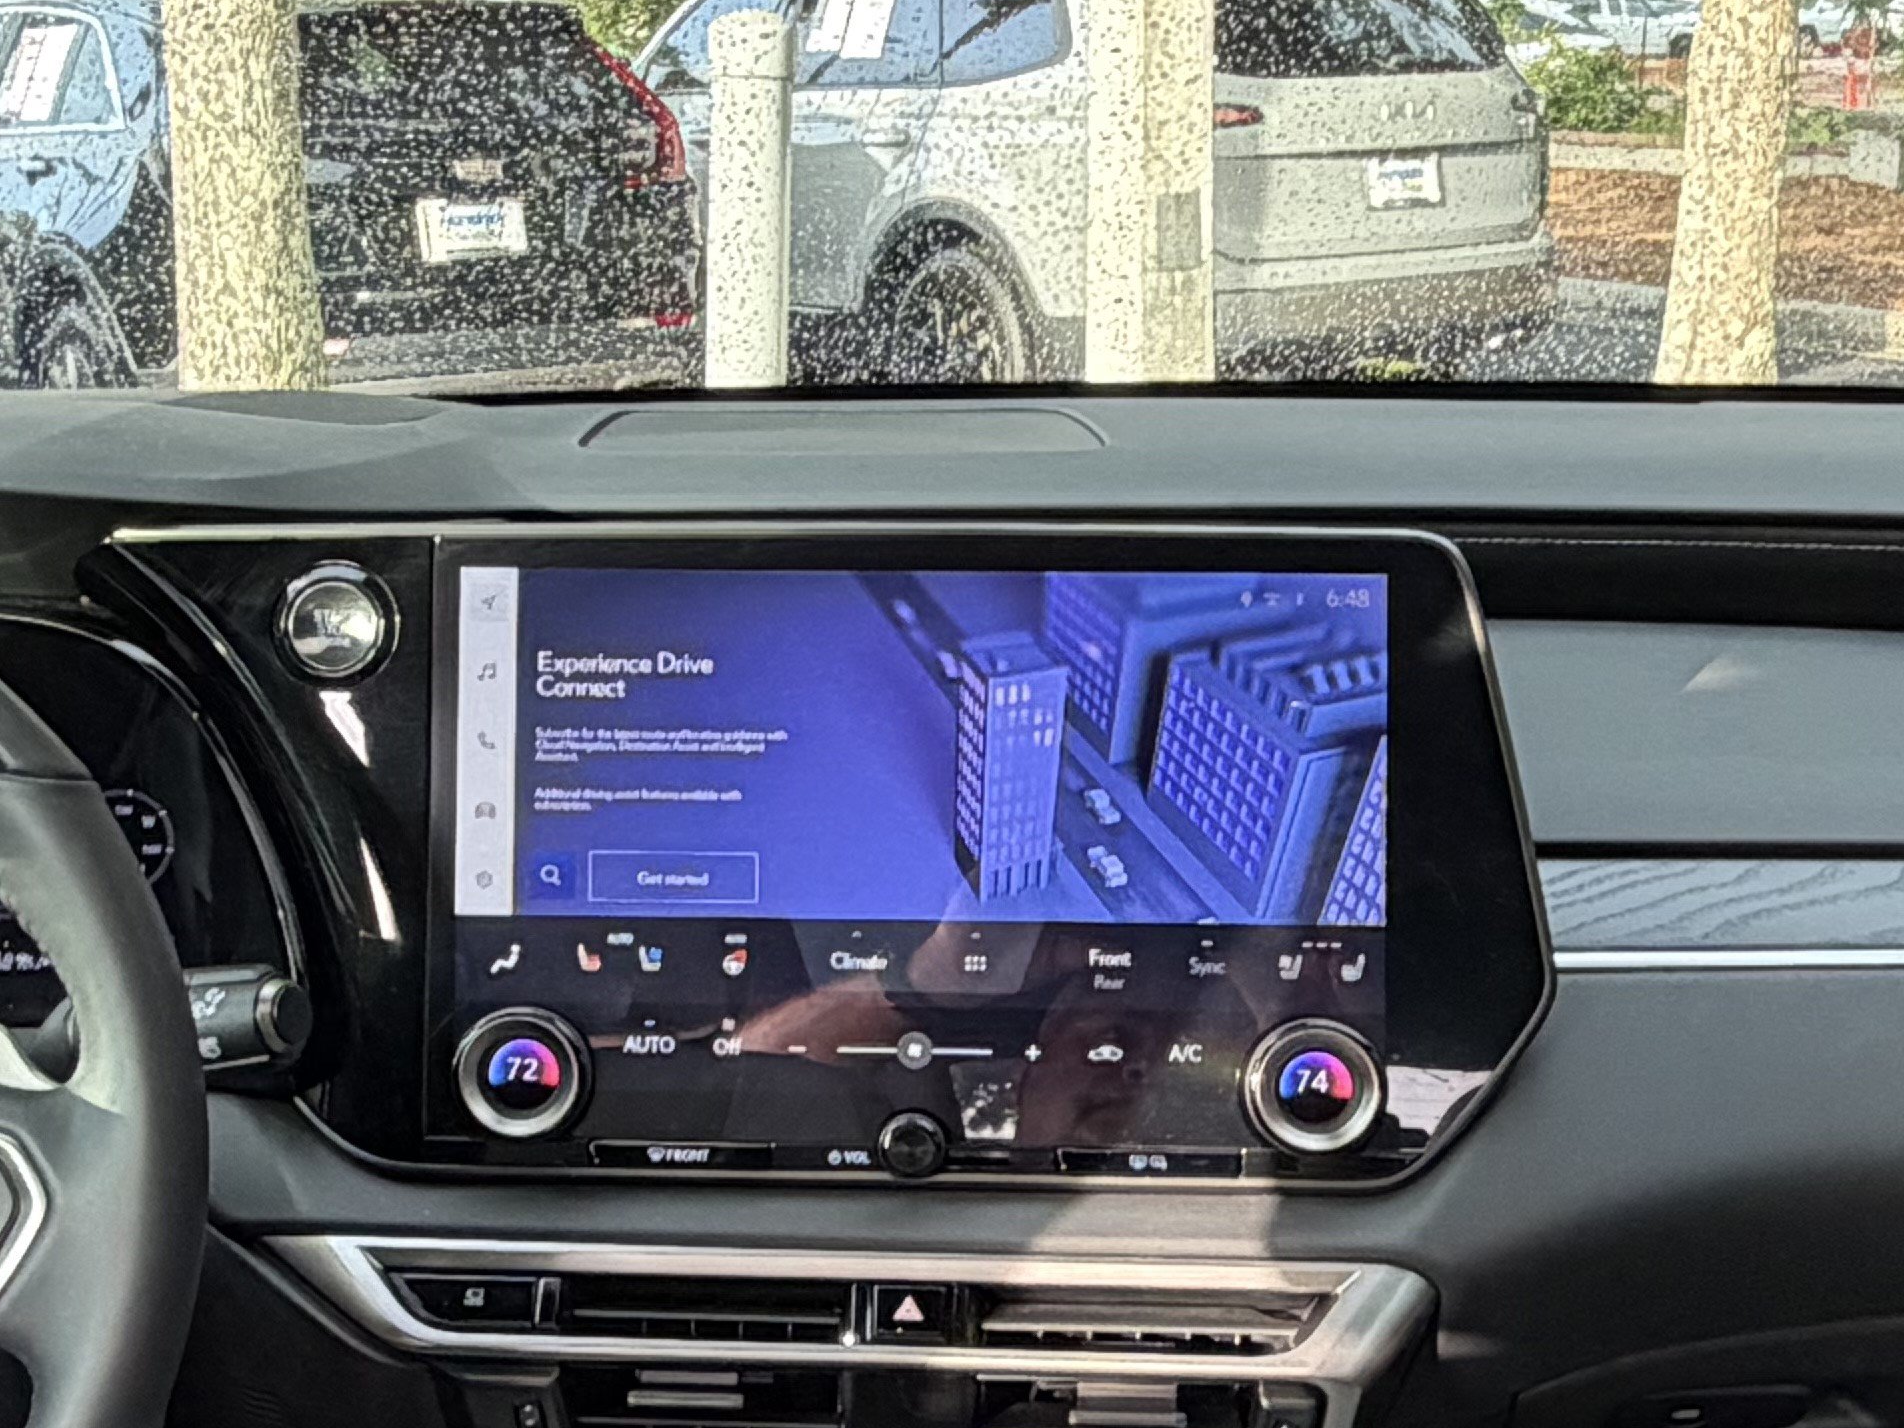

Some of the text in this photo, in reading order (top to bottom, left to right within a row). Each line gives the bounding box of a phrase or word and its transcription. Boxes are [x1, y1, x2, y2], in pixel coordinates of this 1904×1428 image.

[1326, 588, 1371, 608] 6:48
[536, 650, 715, 677] Experience Drive
[535, 675, 626, 698] Connect
[637, 870, 710, 887] Get started
[829, 950, 889, 973] Climate
[1087, 947, 1133, 969] Front
[1188, 956, 1227, 977] Sync
[1093, 974, 1125, 991] Rear
[622, 1035, 677, 1055] AUTO
[712, 1036, 744, 1056] Off
[1168, 1044, 1204, 1065] A/C
[505, 1056, 539, 1082] 72
[1295, 1068, 1330, 1095] 74
[665, 1148, 711, 1164] FRONT
[843, 1149, 871, 1165] VOL
